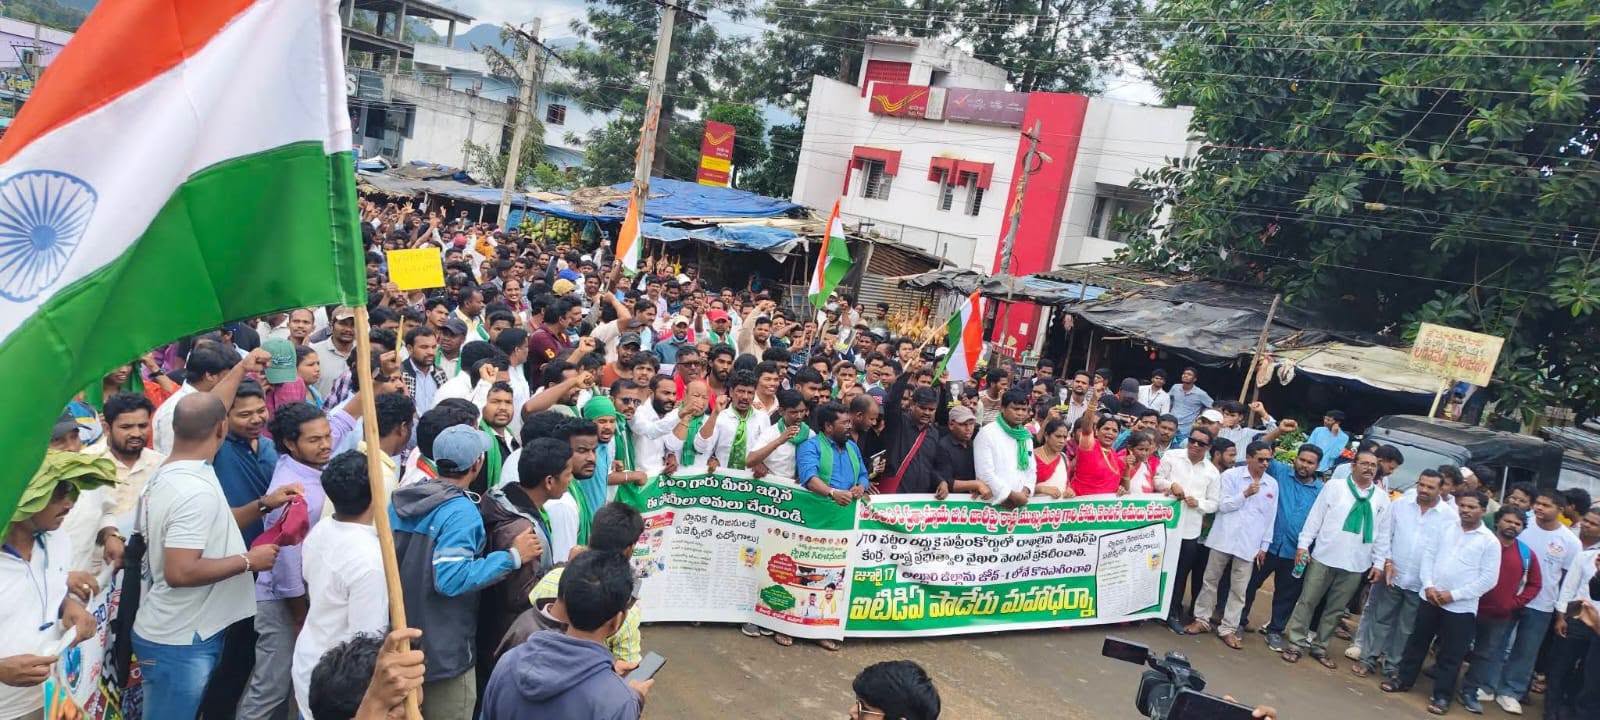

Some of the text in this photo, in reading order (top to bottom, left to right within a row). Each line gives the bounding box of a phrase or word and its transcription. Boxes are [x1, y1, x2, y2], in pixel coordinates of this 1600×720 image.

[690, 476, 718, 489] గారు
[722, 478, 753, 492] మీరు
[756, 484, 792, 504] ఇచ్చిన
[699, 496, 744, 510] అమలు
[880, 534, 906, 550] చట్టం
[943, 536, 1014, 552] సుప్రీంకోర్టులో
[1016, 536, 1054, 548] దాఖలైన
[966, 554, 998, 566] వైఖరి
[1000, 550, 1032, 562] వెంటనే
[854, 568, 882, 586] జూలై
[884, 568, 895, 581] 17
[902, 571, 938, 585] అల్లూరి
[941, 570, 976, 586] జిల్లాను
[850, 584, 925, 621] ఐటిడిఏ
[930, 586, 999, 618] పాడేరు
[1000, 584, 1095, 618] మహాధర్నా
